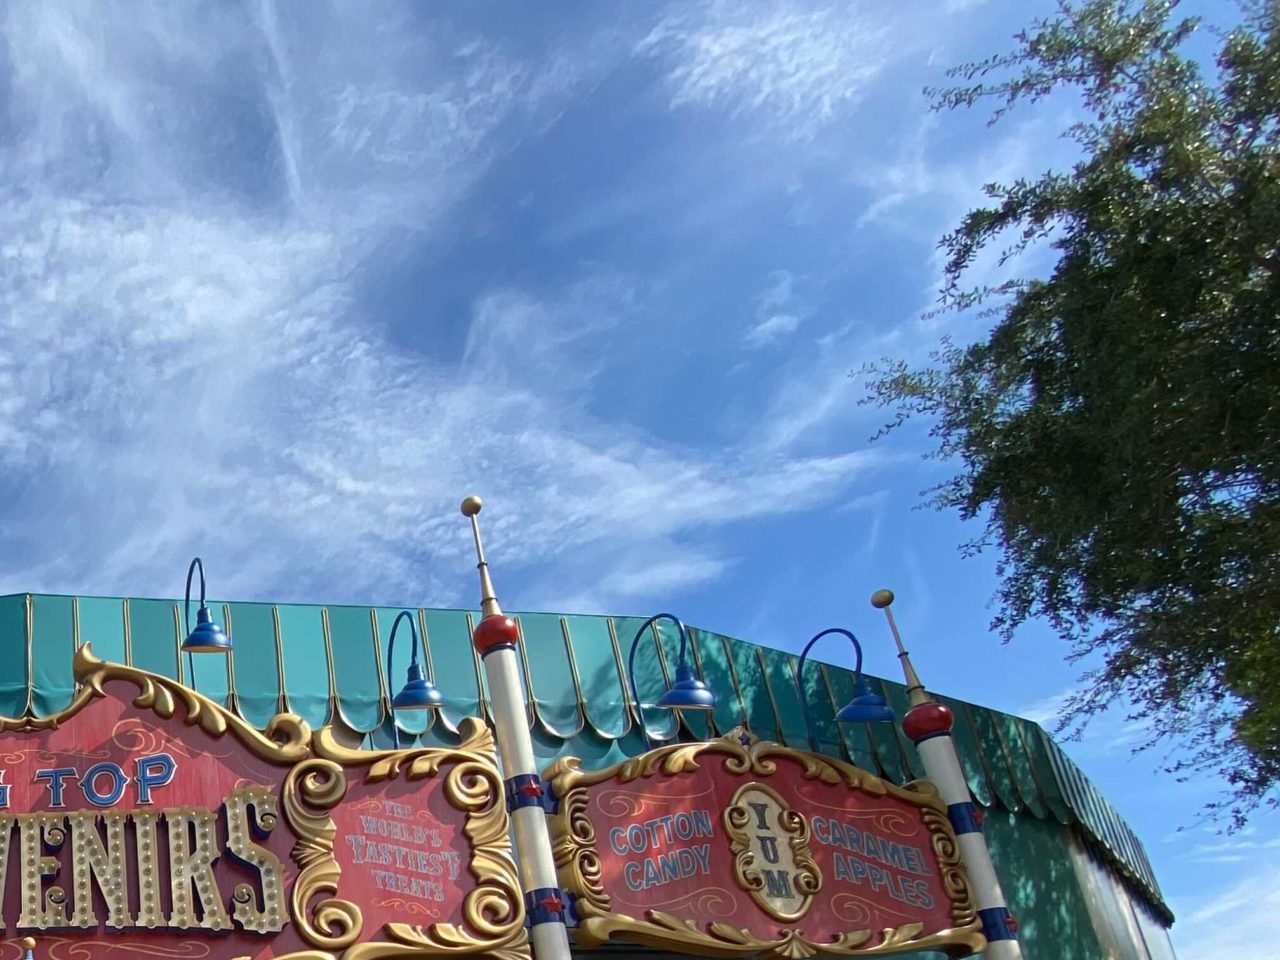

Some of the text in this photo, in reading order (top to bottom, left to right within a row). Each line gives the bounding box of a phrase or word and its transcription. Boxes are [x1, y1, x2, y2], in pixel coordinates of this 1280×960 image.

[33, 753, 179, 809] TOP
[360, 815, 442, 848] WORLD'S
[382, 800, 413, 820] THE
[609, 810, 713, 855] COTTON
[345, 835, 461, 881] TASTIEST
[624, 845, 712, 892] CANDY
[751, 802, 795, 900] YUM
[810, 816, 933, 877] CARAMEL
[371, 870, 444, 902] TREATS
[833, 852, 934, 910] APPLES
